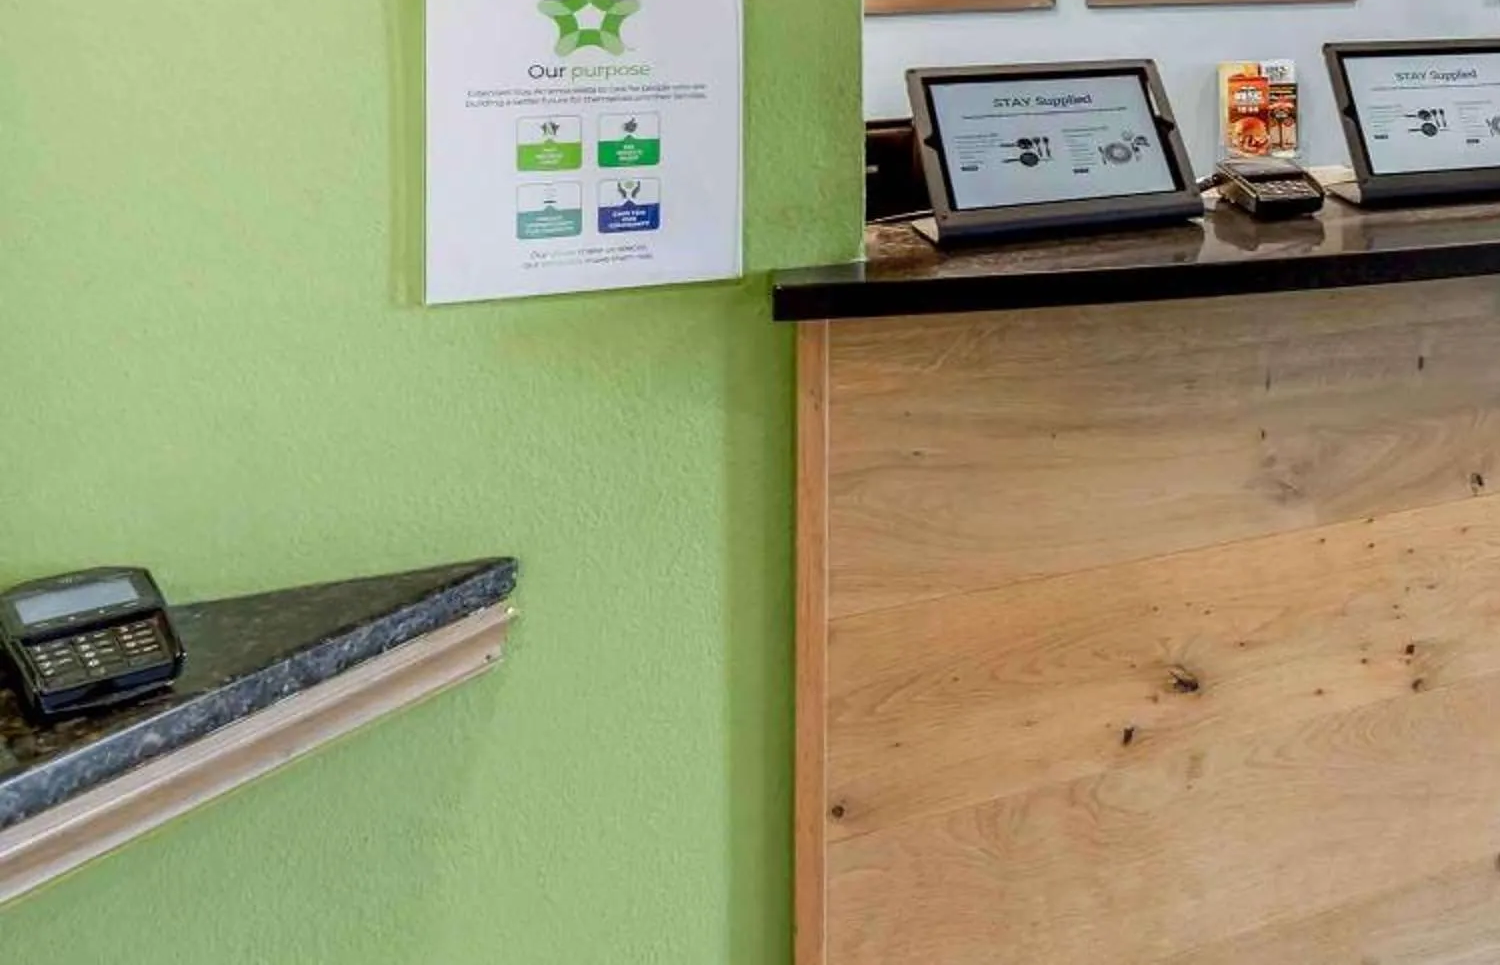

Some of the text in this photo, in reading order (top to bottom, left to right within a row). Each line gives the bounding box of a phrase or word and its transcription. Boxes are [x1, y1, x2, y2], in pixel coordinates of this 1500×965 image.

[527, 62, 651, 82] Our purpose
[1395, 69, 1478, 83] STAY Supplied
[993, 93, 1093, 108] STAY Supplied
